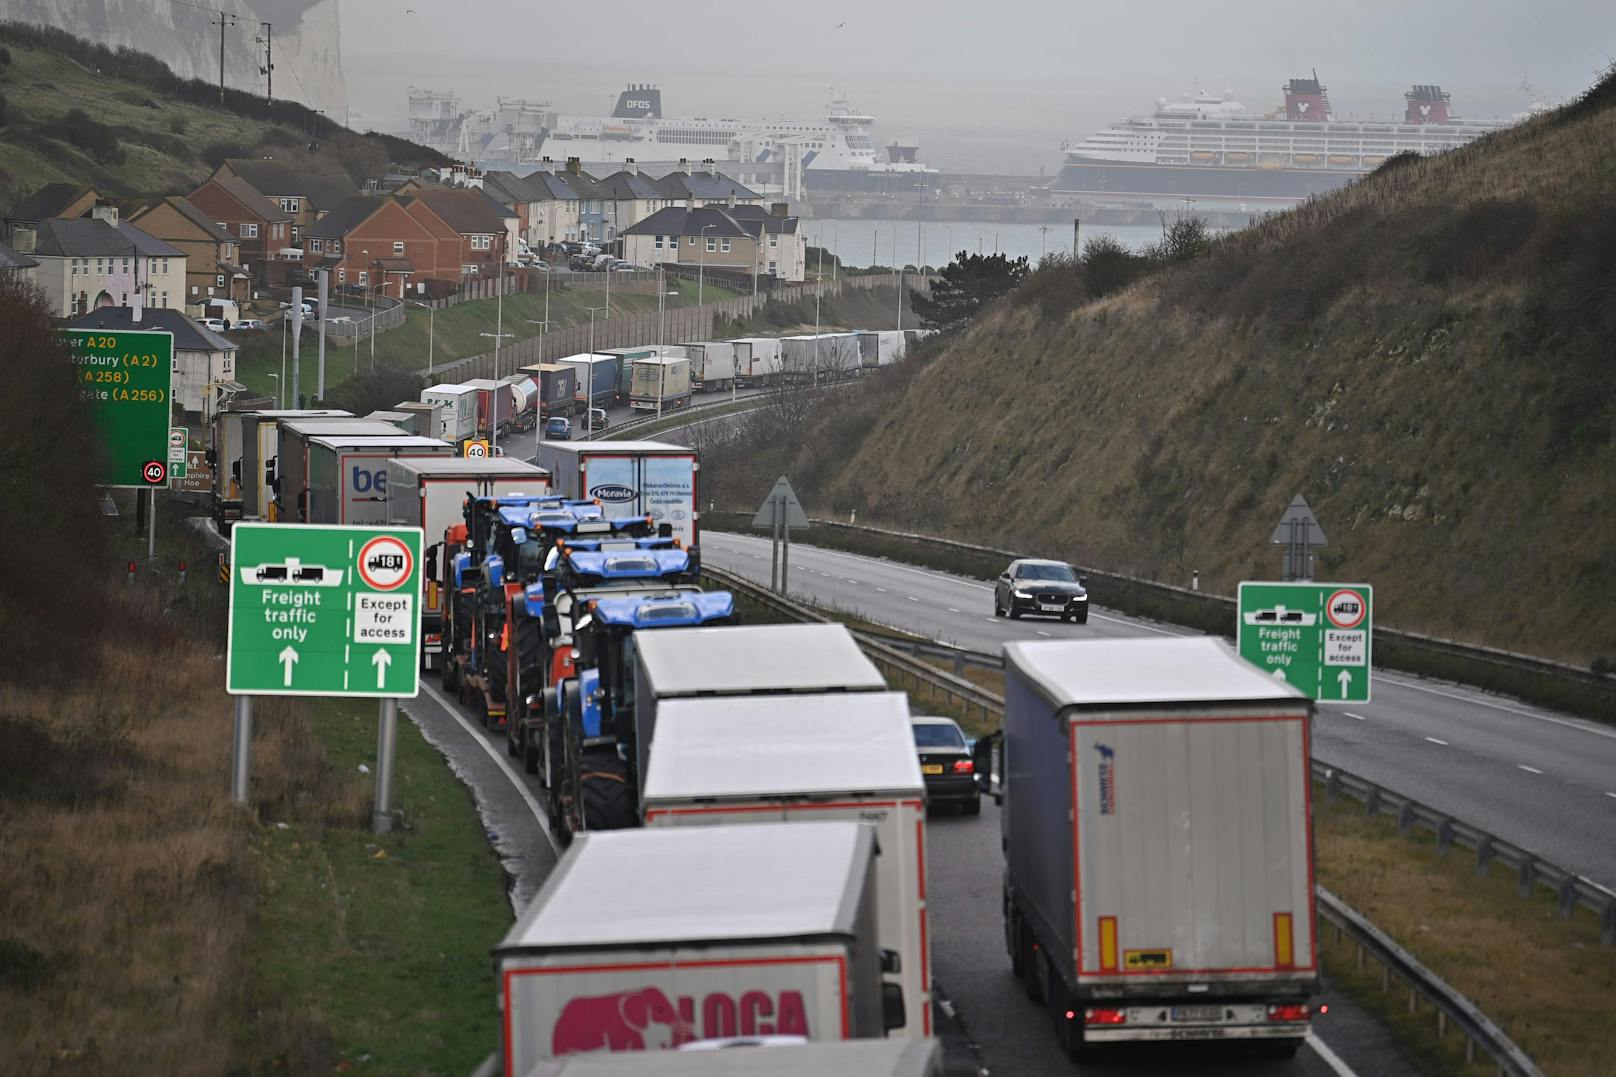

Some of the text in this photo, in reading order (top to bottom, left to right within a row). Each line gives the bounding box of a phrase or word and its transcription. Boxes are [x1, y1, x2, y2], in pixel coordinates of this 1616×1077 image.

[626, 100, 650, 109] DFDS
[86, 337, 117, 348] A20
[123, 353, 158, 367] (A2)
[112, 388, 164, 402] (A256)
[469, 448, 484, 457] 40
[147, 467, 161, 477] 40
[597, 488, 632, 498] Moravia
[262, 589, 321, 607] Freight
[361, 598, 408, 611] Except
[265, 608, 316, 623] traffic
[373, 612, 393, 624] for
[272, 625, 308, 643] only
[360, 628, 406, 638] access
[1259, 628, 1301, 643] Freight
[1329, 632, 1362, 643] Except
[1261, 641, 1298, 652] traffic
[1338, 643, 1353, 652] for
[1266, 654, 1292, 666] only
[1329, 655, 1361, 663] access
